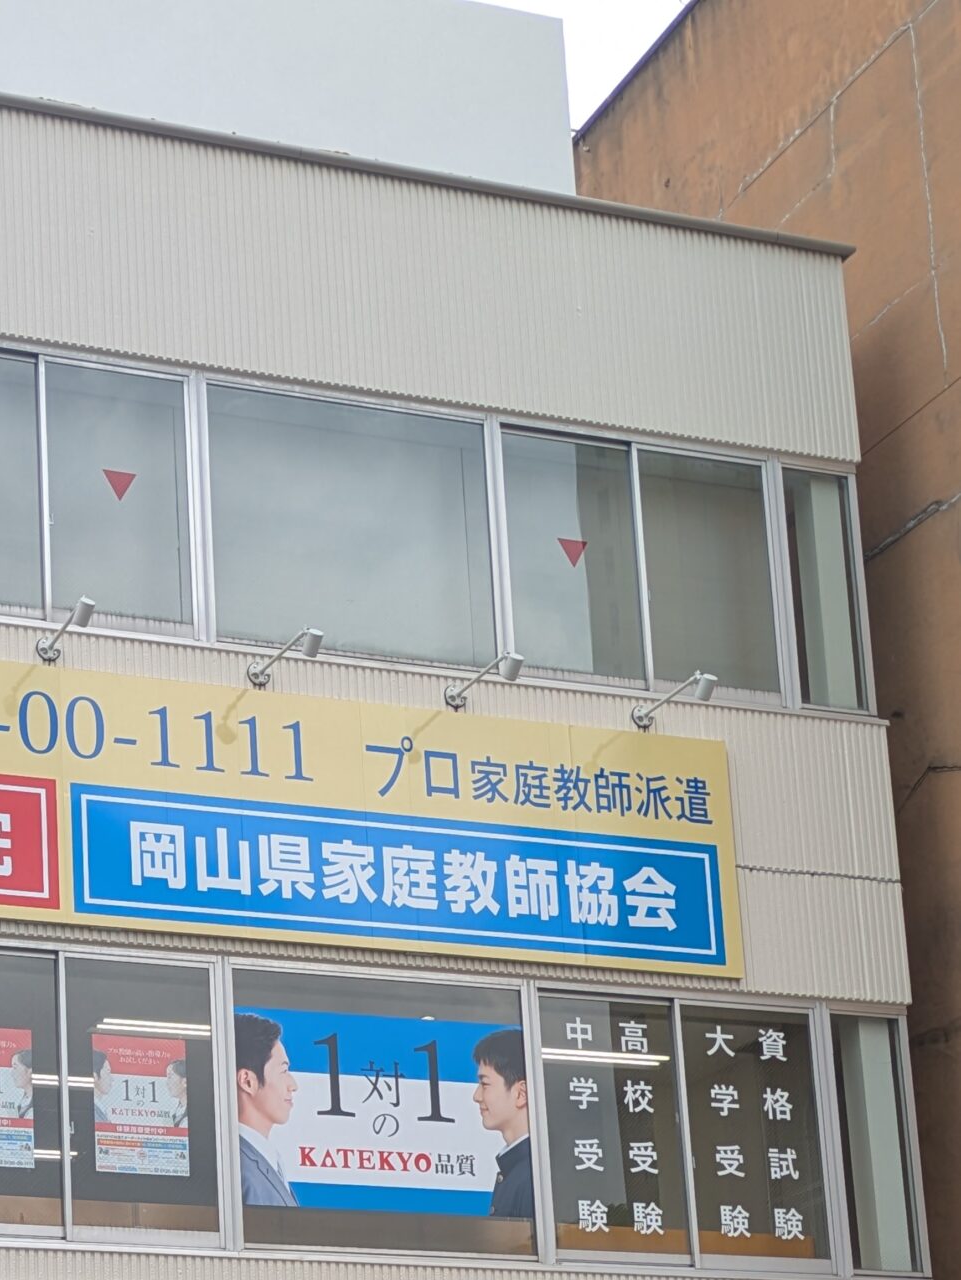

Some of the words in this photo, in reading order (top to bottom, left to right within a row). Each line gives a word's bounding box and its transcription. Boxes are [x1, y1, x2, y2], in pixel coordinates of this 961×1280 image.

[365, 736, 715, 826] プロ家庭教師派遣
[129, 820, 679, 932] 岡山県家庭教師協会
[122, 1079, 159, 1103] 1対1
[313, 1033, 456, 1123] 1対1
[372, 1113, 400, 1137] の
[565, 1016, 610, 1233] 中学受験
[618, 1020, 664, 1236] 高校受験
[298, 1146, 476, 1177] KATEKYO品質
[705, 1025, 752, 1238] 大学受験
[758, 1028, 805, 1241] 資格試験
